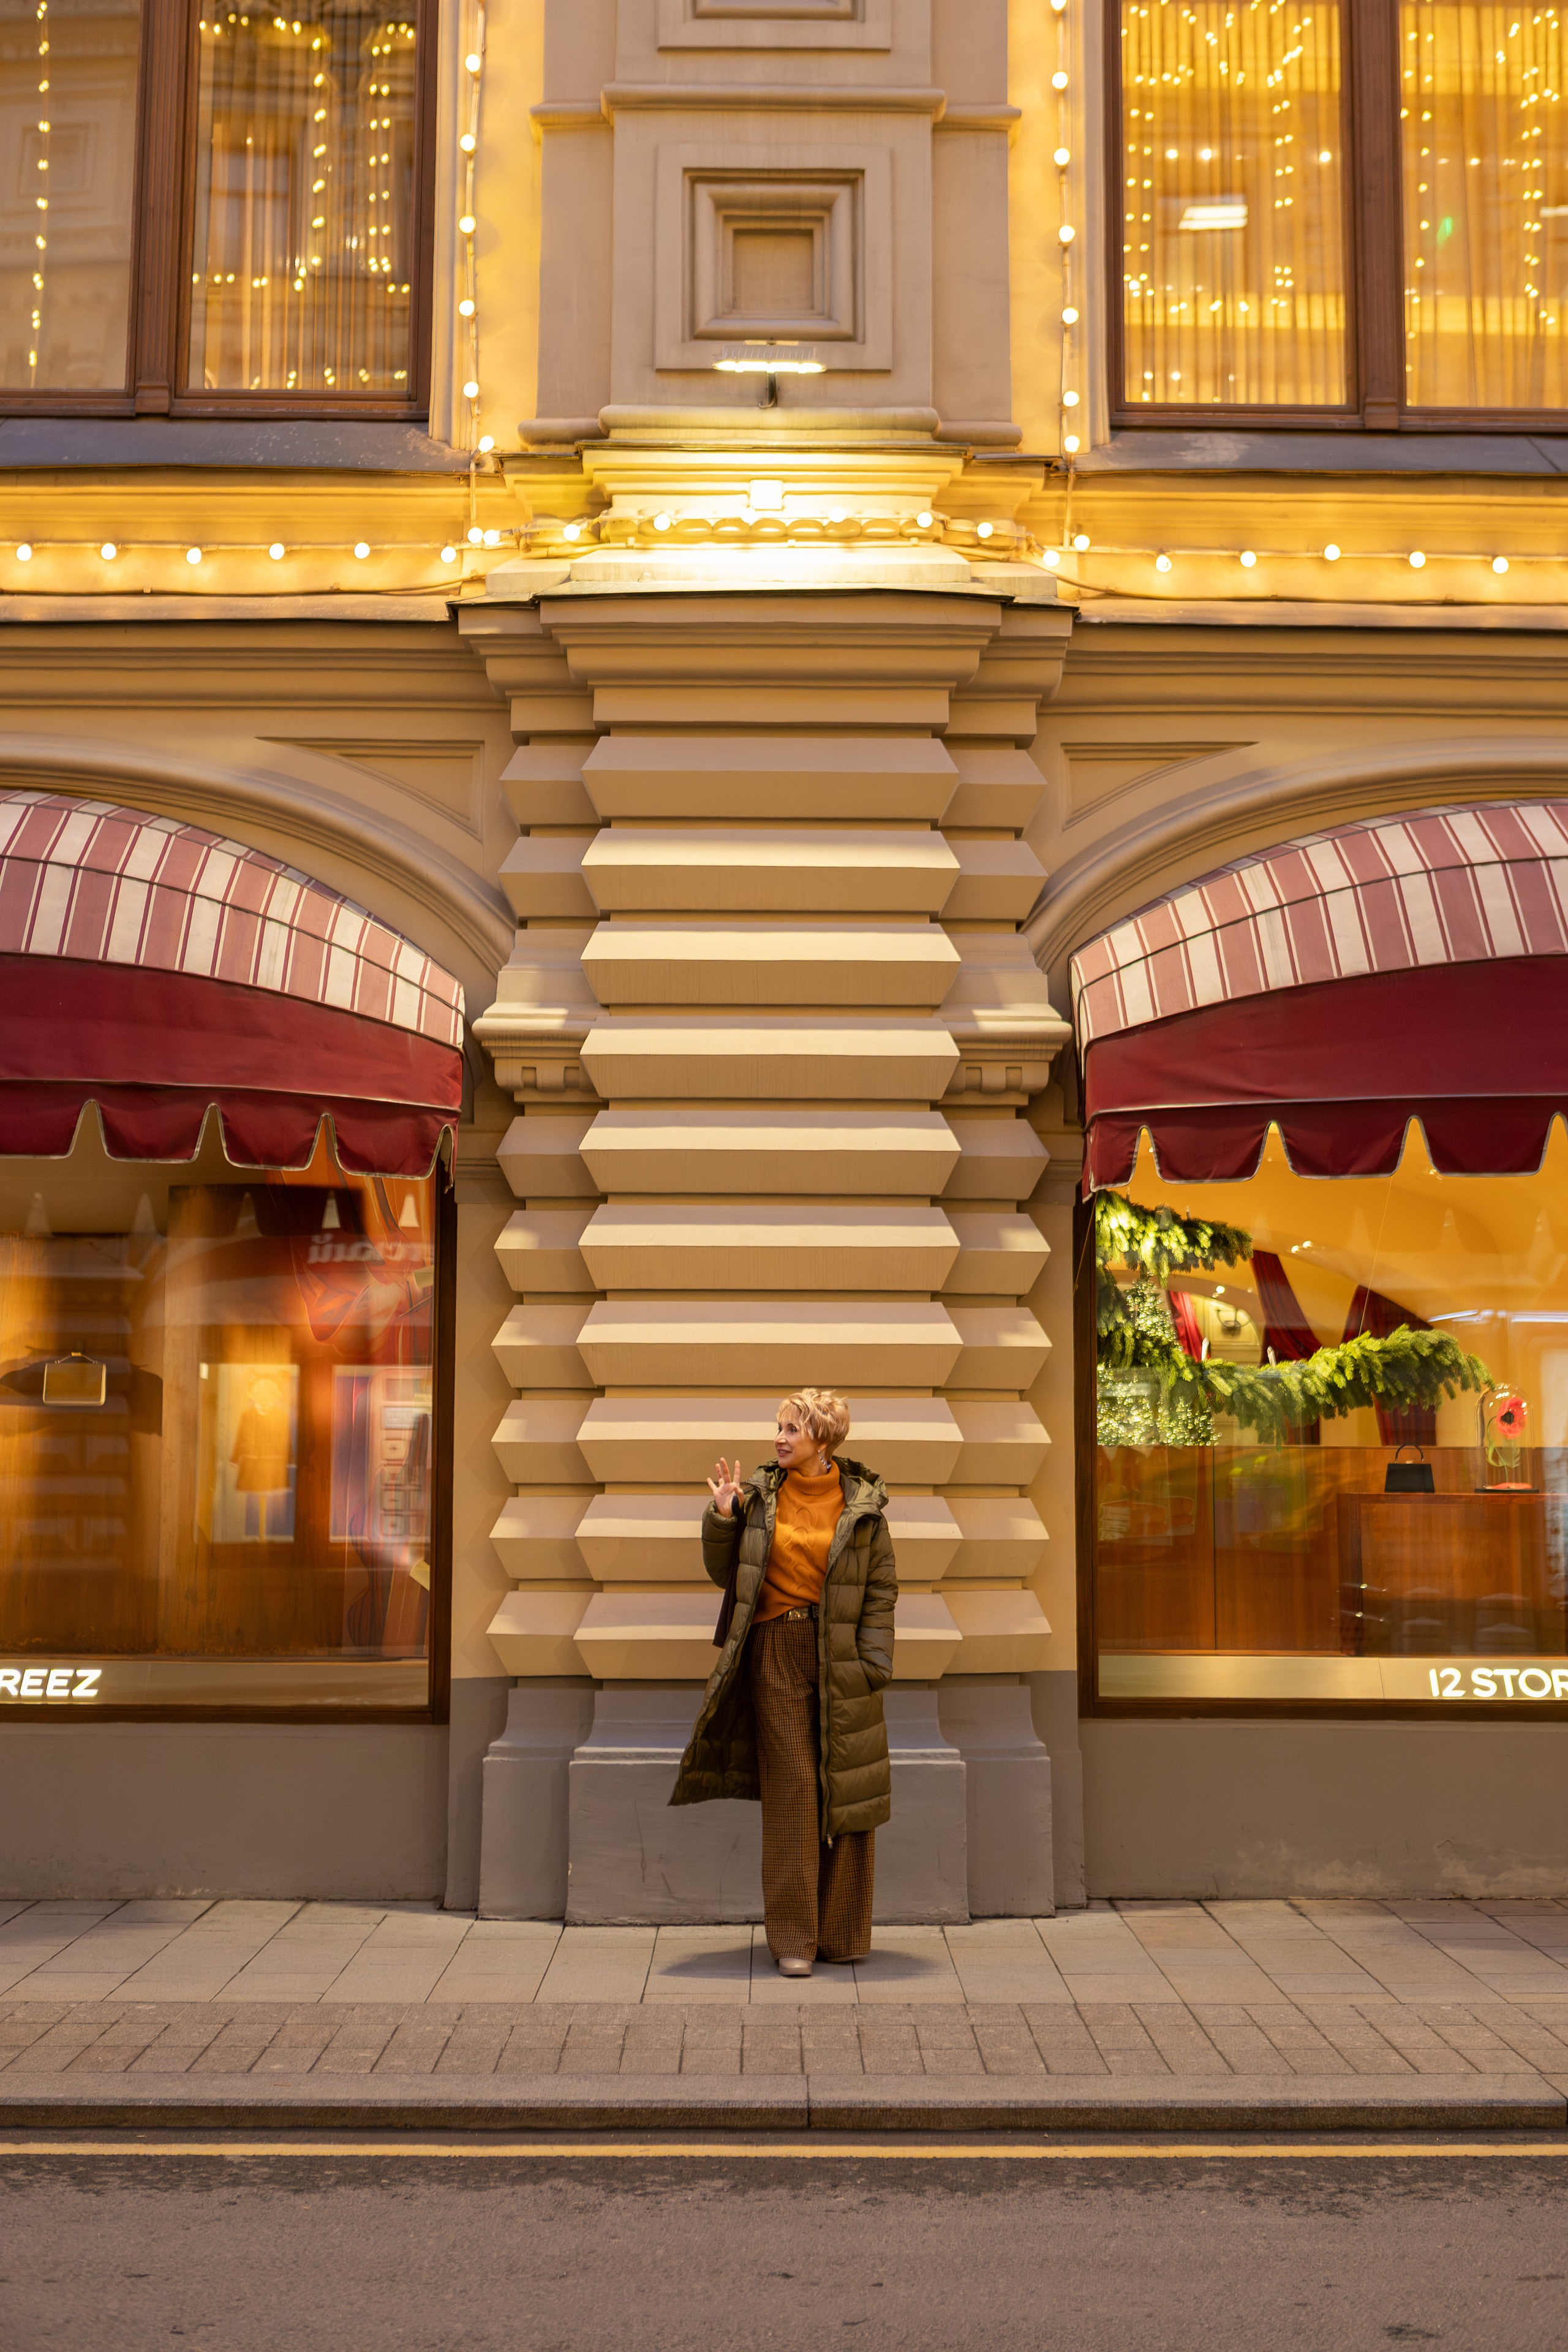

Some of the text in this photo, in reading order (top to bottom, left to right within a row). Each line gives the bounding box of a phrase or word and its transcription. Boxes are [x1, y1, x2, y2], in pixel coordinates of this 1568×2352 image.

[0, 1668, 102, 1697] REEZ
[1429, 1667, 1568, 1698] 12 STOR
